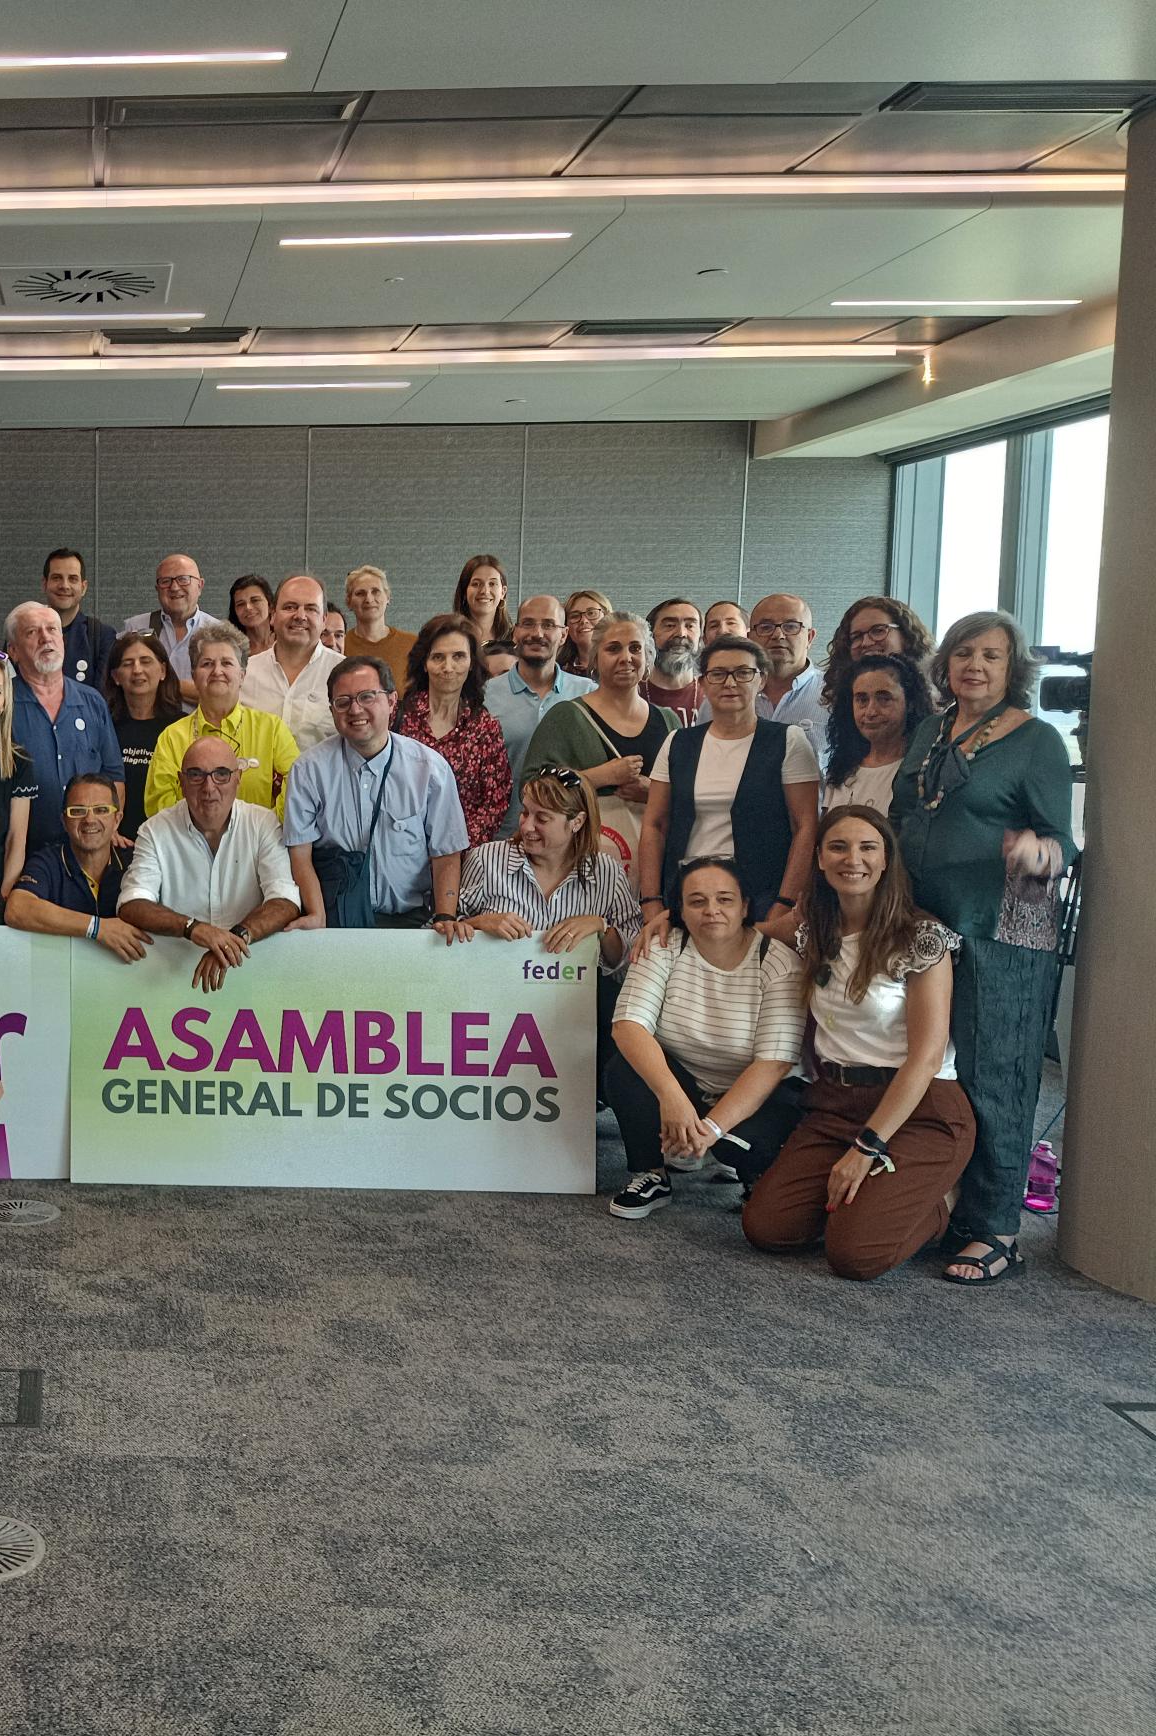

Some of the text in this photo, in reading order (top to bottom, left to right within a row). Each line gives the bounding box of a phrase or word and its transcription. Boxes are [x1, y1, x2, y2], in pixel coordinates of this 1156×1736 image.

[121, 755, 151, 765] diagnó
[522, 960, 587, 980] feder
[102, 1007, 559, 1079] ASAMBLEA
[101, 1078, 561, 1122] GENERAL DE SOCIOS
